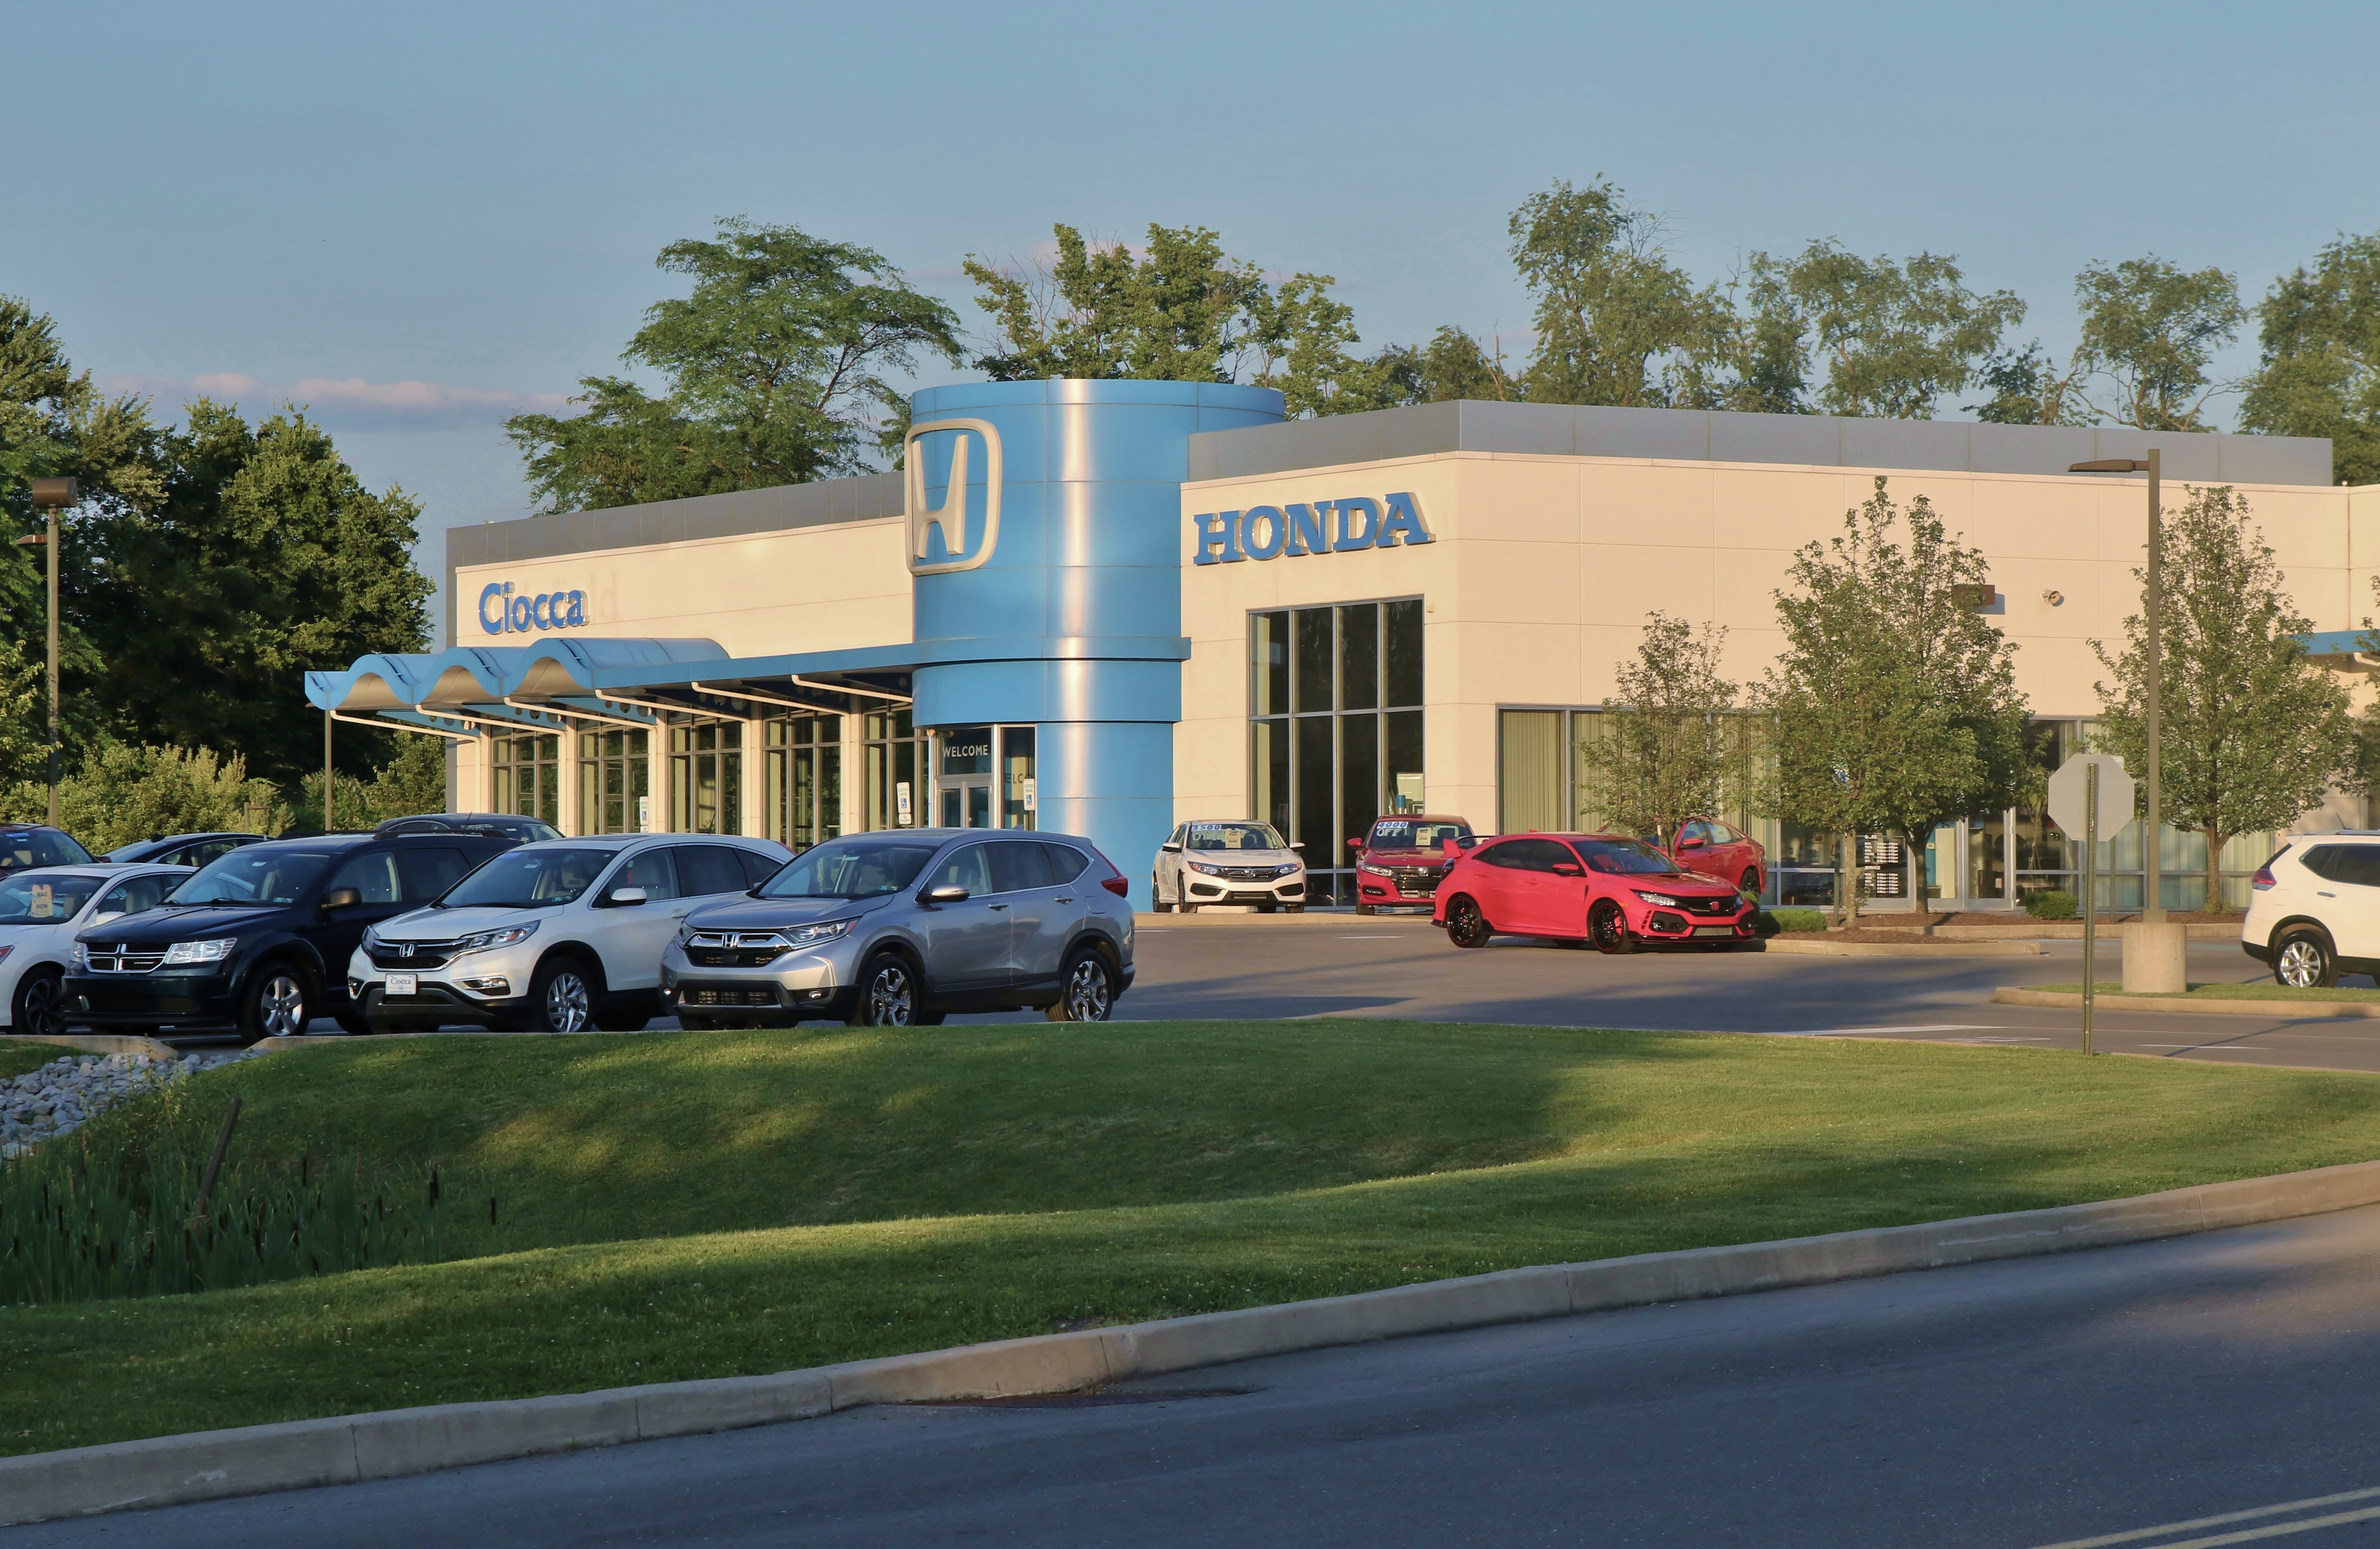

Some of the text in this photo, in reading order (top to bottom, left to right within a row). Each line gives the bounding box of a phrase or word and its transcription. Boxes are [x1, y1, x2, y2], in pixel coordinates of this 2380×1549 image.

[1193, 492, 1436, 566] HONDA
[479, 581, 590, 635] Ciocca
[943, 744, 988, 757] WELCOME
